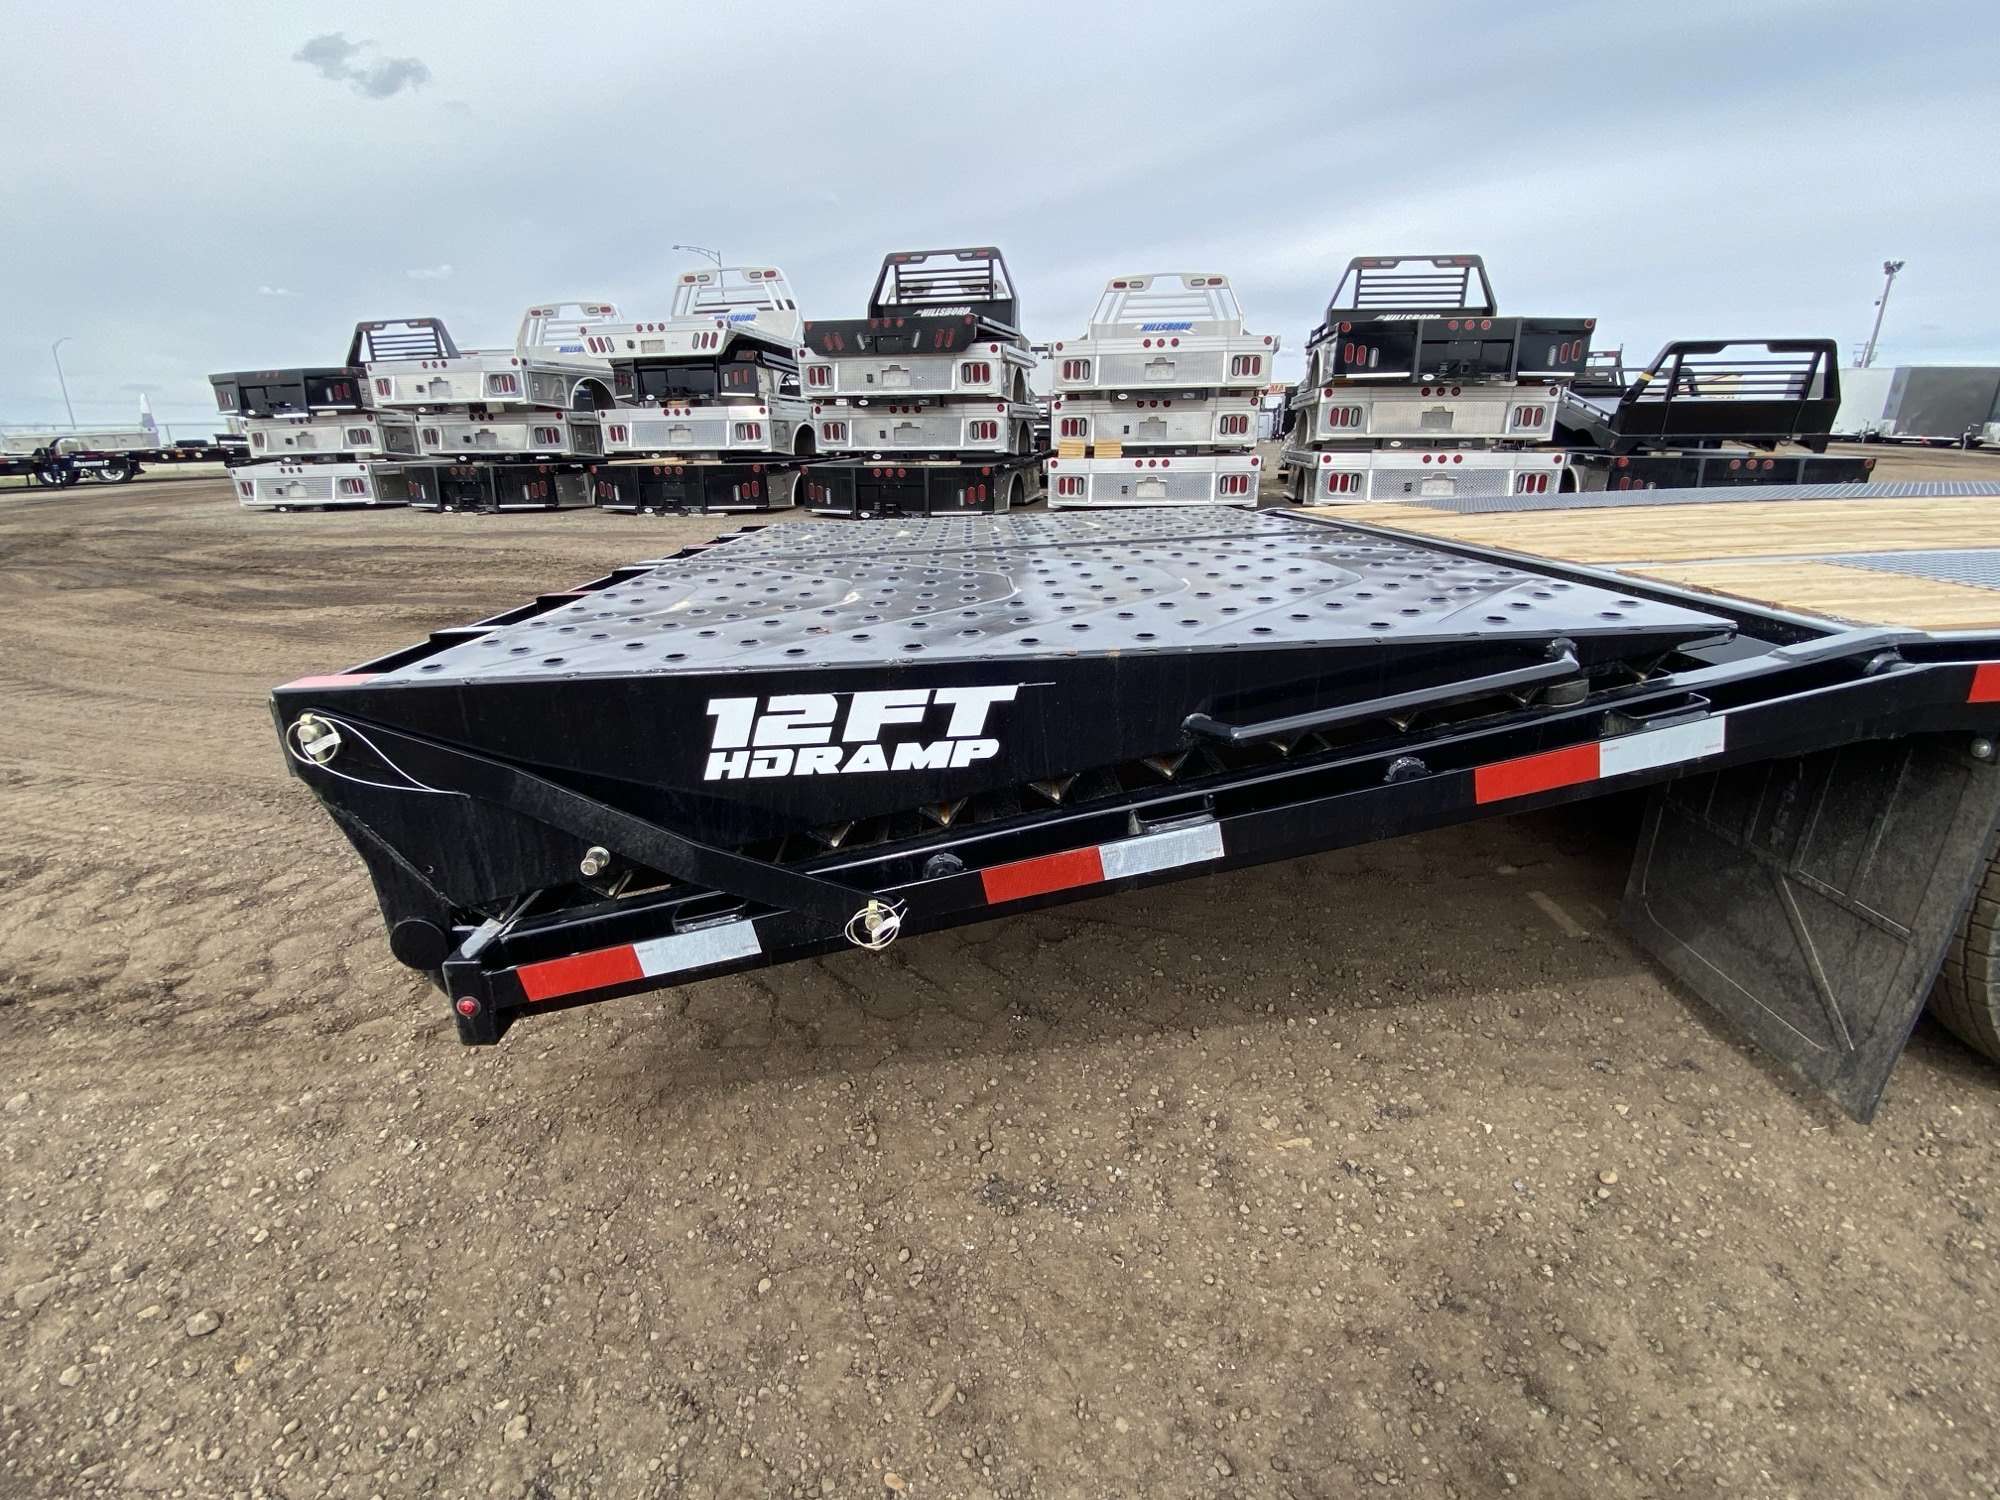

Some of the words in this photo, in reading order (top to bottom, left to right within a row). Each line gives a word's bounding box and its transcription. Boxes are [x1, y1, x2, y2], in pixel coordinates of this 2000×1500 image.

[1140, 321, 1193, 332] HILLSBORO
[706, 685, 1019, 749] 12FT
[704, 738, 1000, 781] HDRAMP
